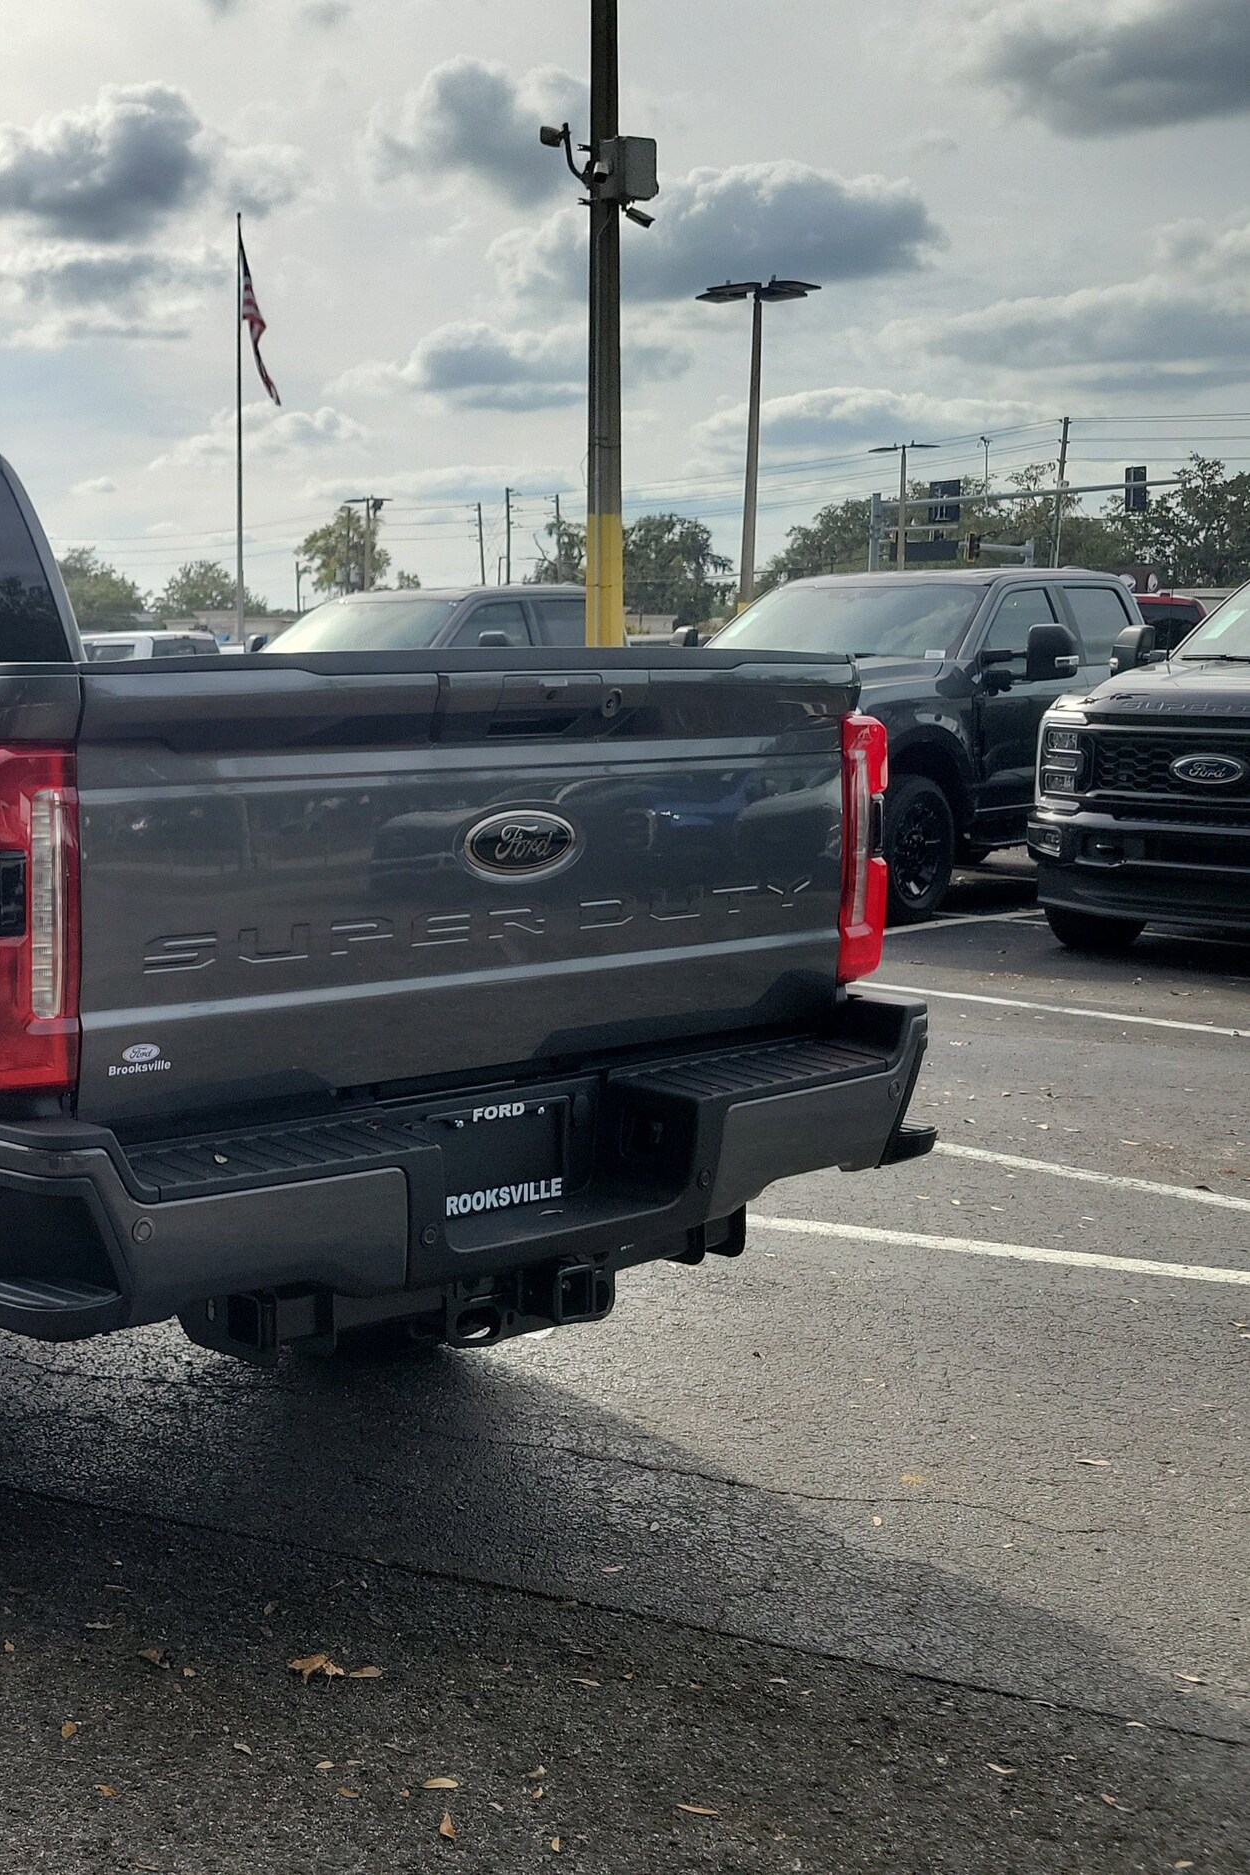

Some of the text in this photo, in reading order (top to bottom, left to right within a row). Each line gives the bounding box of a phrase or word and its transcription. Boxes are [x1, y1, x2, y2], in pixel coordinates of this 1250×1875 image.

[1188, 762, 1227, 779] Ford
[494, 824, 553, 860] Ford
[143, 874, 811, 974] SUPER DUTY
[130, 1046, 153, 1059] Ford
[108, 1060, 171, 1076] Brooksville
[472, 1102, 525, 1122] FORD
[446, 1177, 563, 1216] ROOKSVILLE
